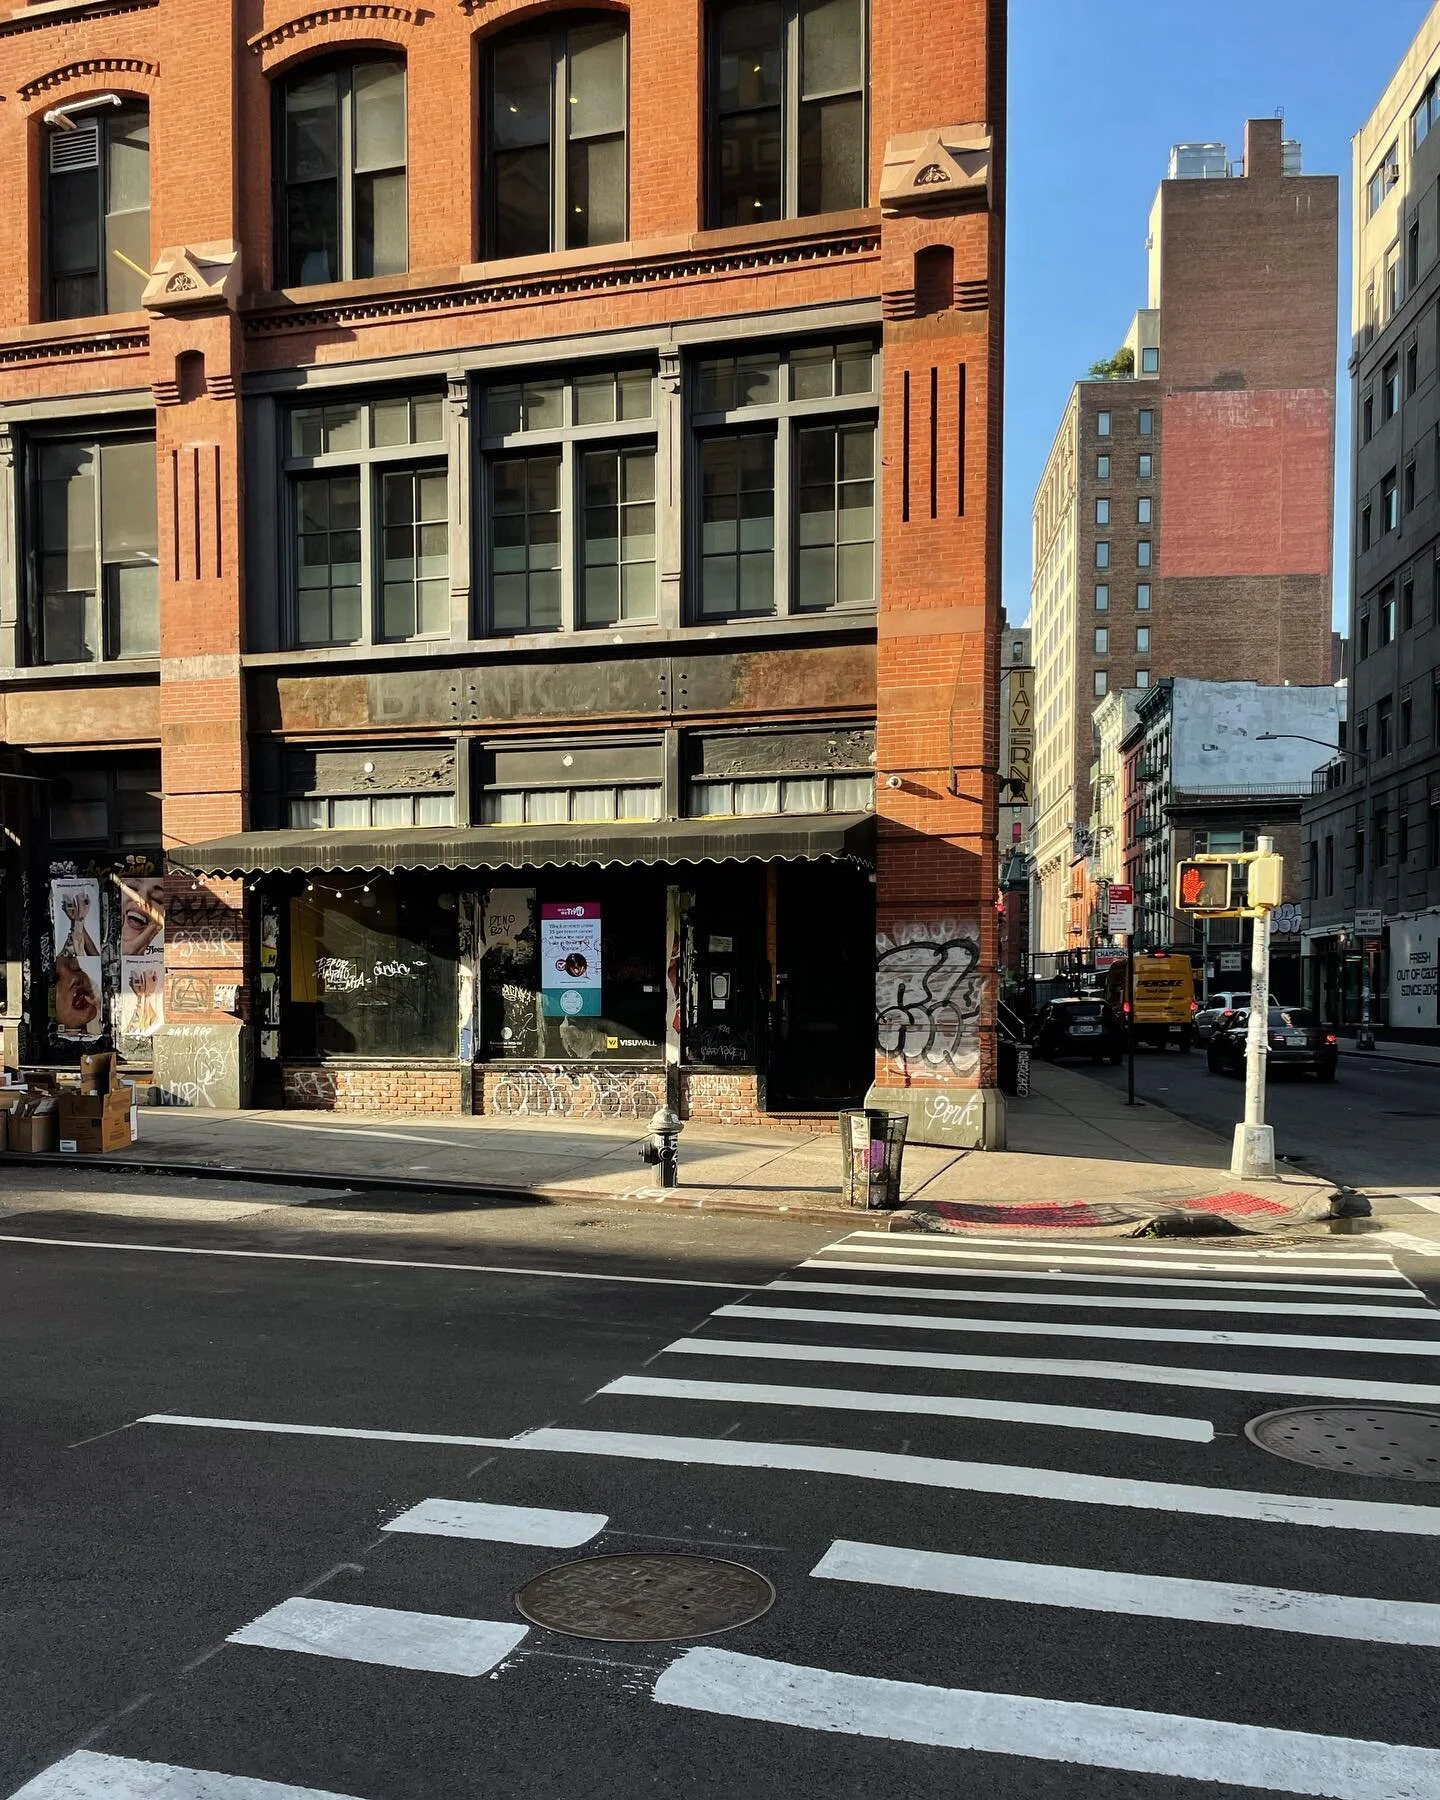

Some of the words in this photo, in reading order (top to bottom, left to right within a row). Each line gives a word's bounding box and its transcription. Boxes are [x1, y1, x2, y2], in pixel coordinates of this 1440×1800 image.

[490, 914, 516, 927] DINO
[490, 925, 511, 937] BOY
[1409, 951, 1431, 964] FRESH
[1397, 968, 1410, 981] OUT
[1411, 968, 1421, 980] OF
[1136, 979, 1185, 987] PENSKE
[1401, 984, 1422, 996] SINCE
[620, 1039, 657, 1047] VISUWALL
